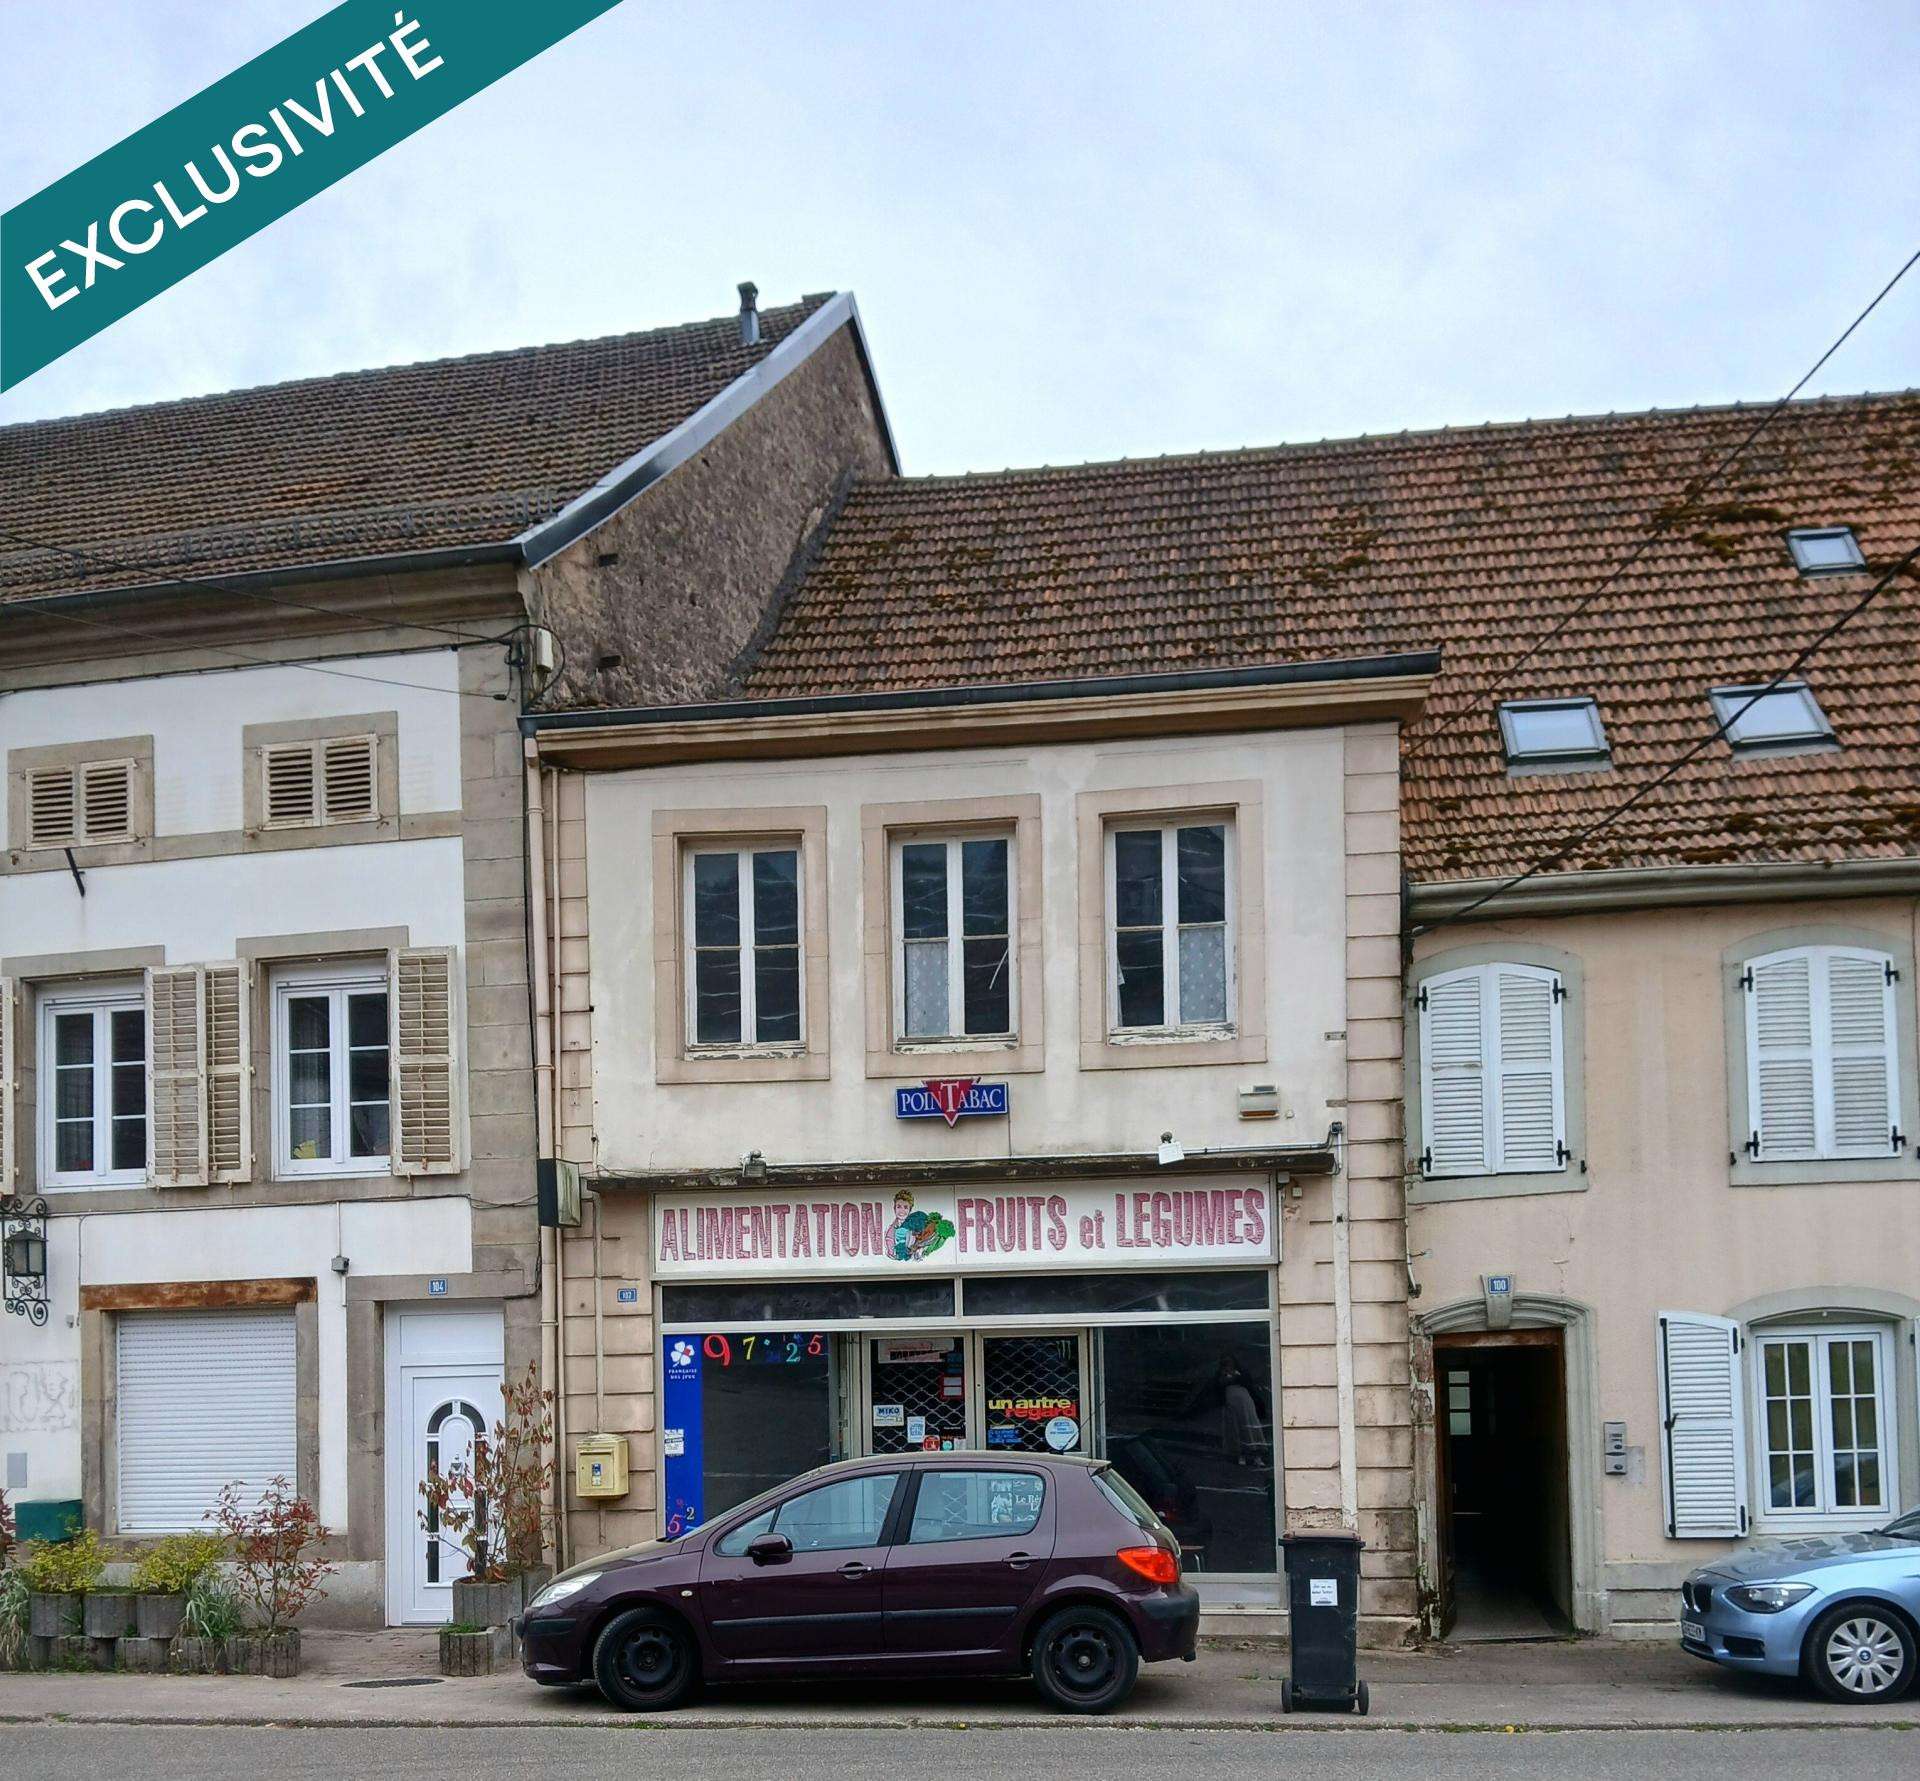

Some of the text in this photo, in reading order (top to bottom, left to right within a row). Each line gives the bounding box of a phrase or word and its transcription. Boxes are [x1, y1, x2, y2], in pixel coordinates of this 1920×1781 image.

[660, 1188, 1266, 1261] ALIMENTATION FRUITS et LEGUMES
[432, 1281, 444, 1292] 104
[1493, 1280, 1506, 1291] 100
[703, 1334, 823, 1367] 9 7 2 5
[988, 1397, 1072, 1410] un autre
[877, 1406, 900, 1415] MIKO
[1005, 1403, 1077, 1421] regard
[686, 1507, 695, 1520] 2
[667, 1514, 685, 1534] 5
